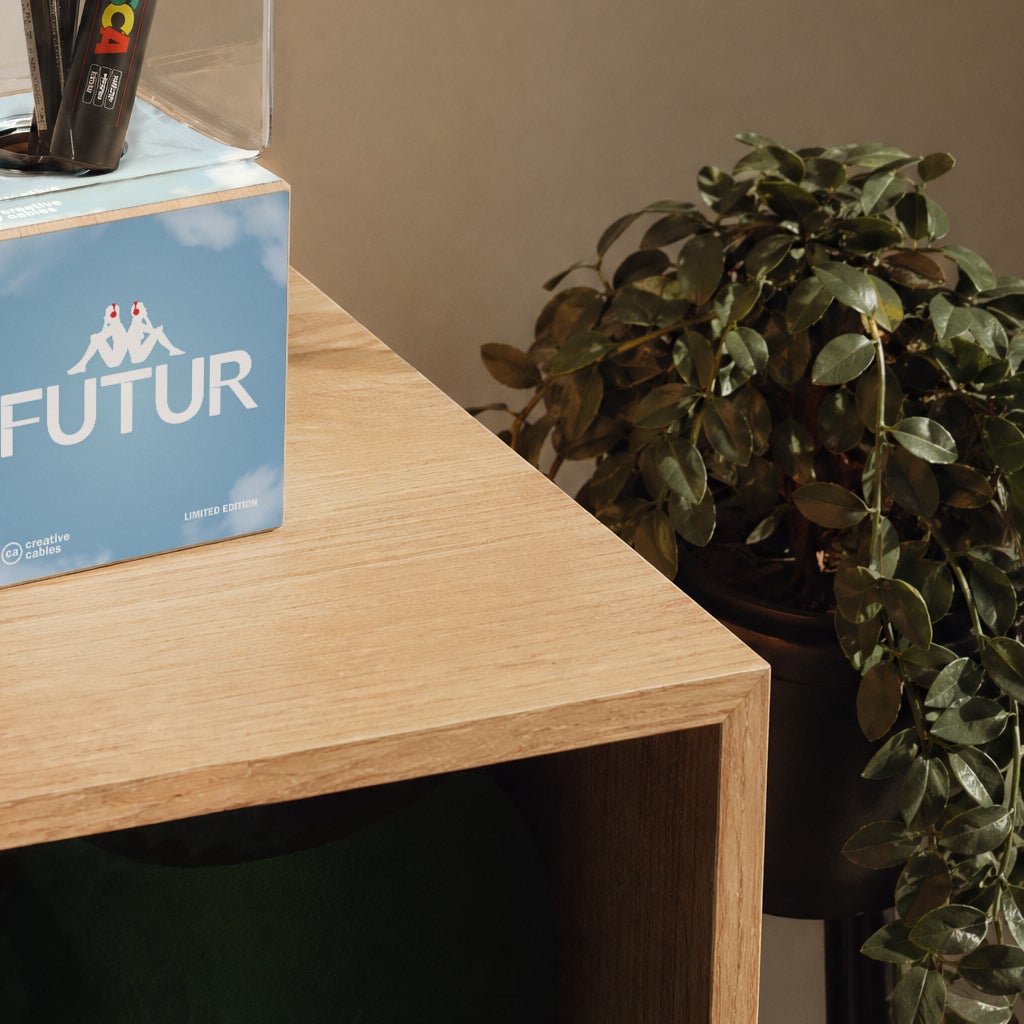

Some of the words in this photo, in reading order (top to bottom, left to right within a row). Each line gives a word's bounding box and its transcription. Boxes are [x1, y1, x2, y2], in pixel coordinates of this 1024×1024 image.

[0, 349, 258, 458] FUTUR
[184, 505, 221, 522] LIMITED
[222, 497, 258, 515] EDITION
[25, 531, 71, 549] creative
[25, 543, 62, 560] cables
